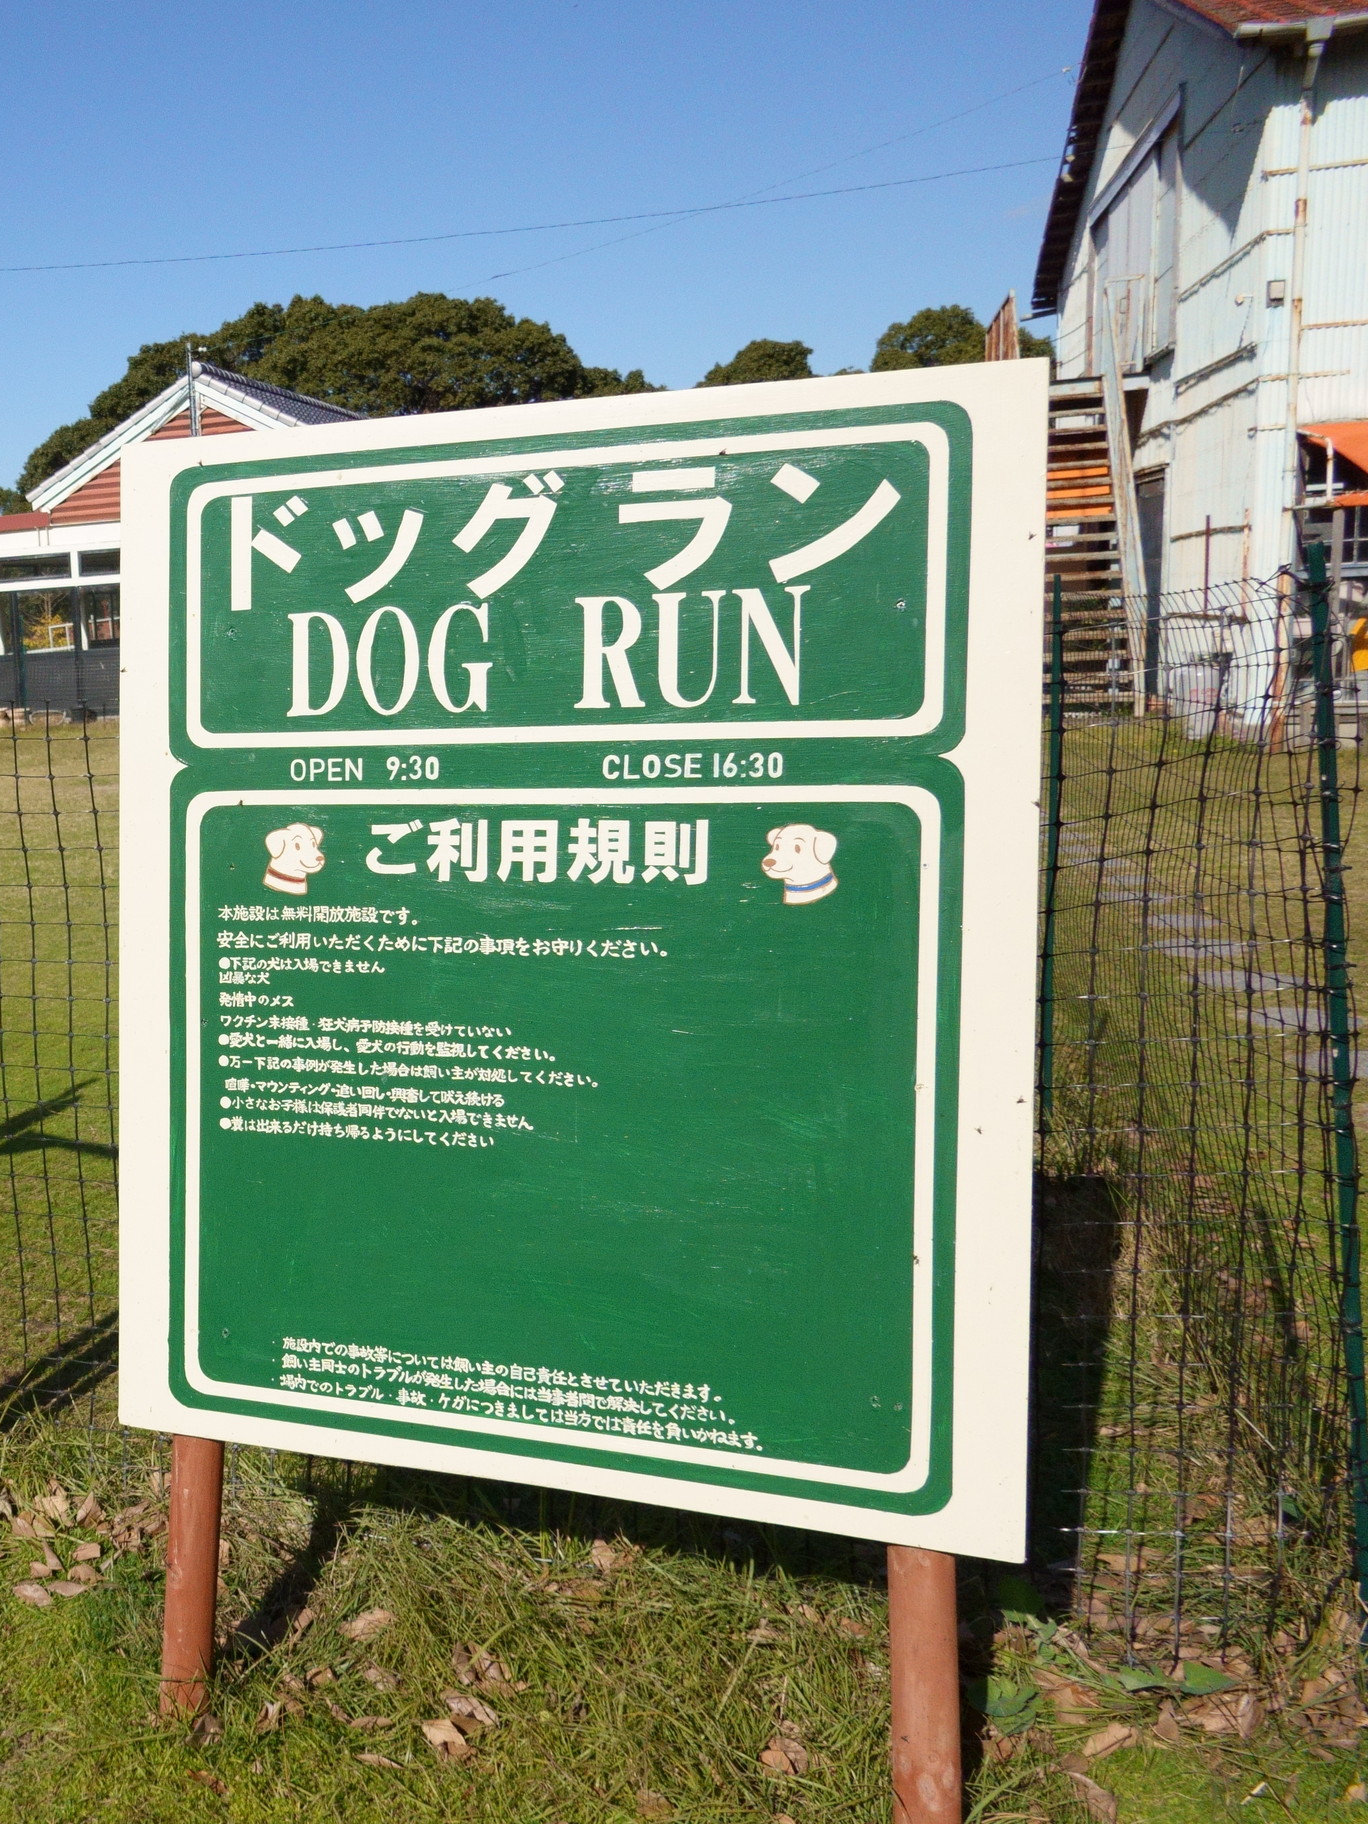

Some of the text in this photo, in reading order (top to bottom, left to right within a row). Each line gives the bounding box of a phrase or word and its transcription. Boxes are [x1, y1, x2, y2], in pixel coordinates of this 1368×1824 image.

[286, 584, 812, 718] DOG RUN
[290, 755, 440, 783] OPEN 9:30
[602, 752, 784, 780] CLOSE 16:30
[364, 818, 711, 886] ご利用規則
[218, 905, 419, 925] 本施設は無料開放施設です。
[217, 930, 668, 958] 安全にご利用いただくために下記の事項をお守りください。
[219, 971, 270, 985] 凶暴な犬
[219, 991, 294, 1007] 発情中のメス
